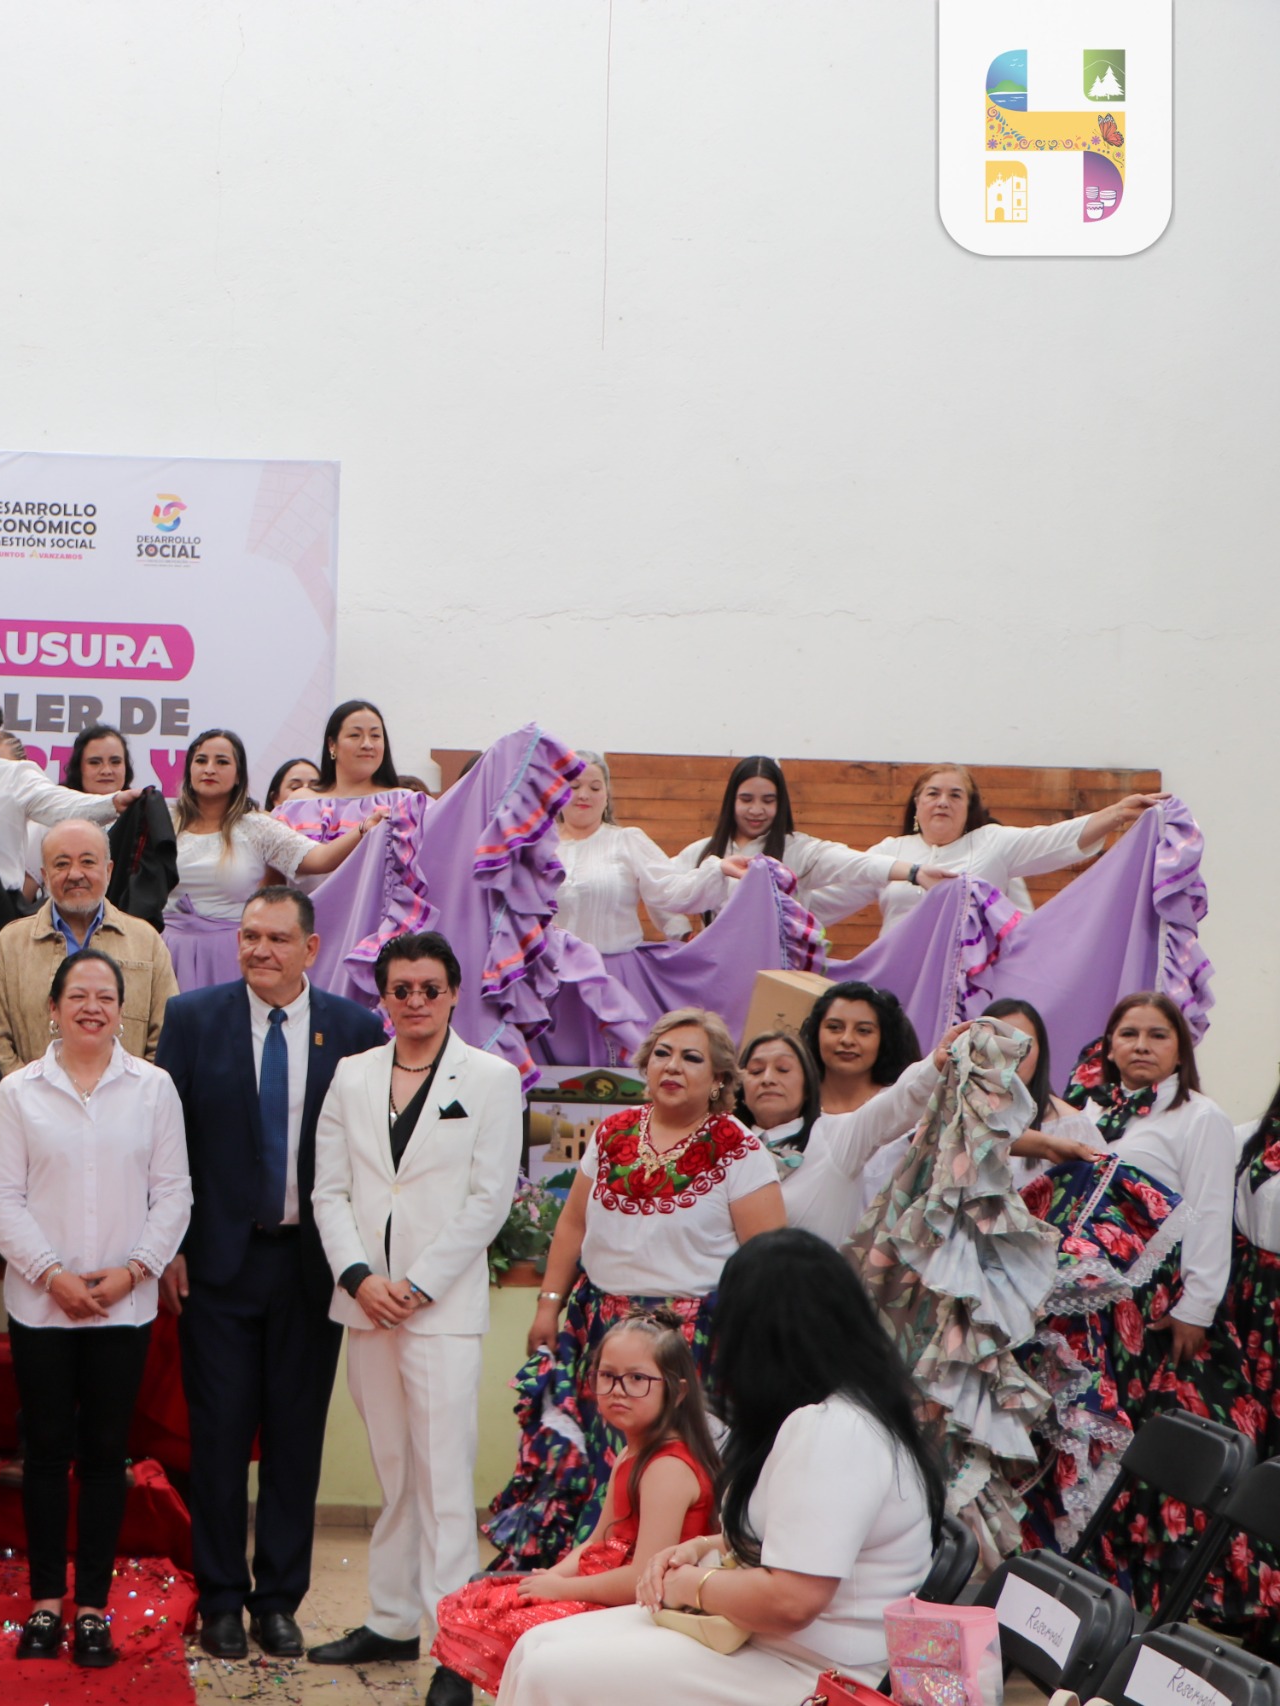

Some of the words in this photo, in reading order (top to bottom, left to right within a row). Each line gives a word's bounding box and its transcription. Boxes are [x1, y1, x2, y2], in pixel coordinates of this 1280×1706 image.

[50, 537, 97, 550] SOCIAL
[136, 535, 202, 545] DESARROLLO
[136, 543, 201, 559] SOCIAL
[119, 696, 190, 736] DE
